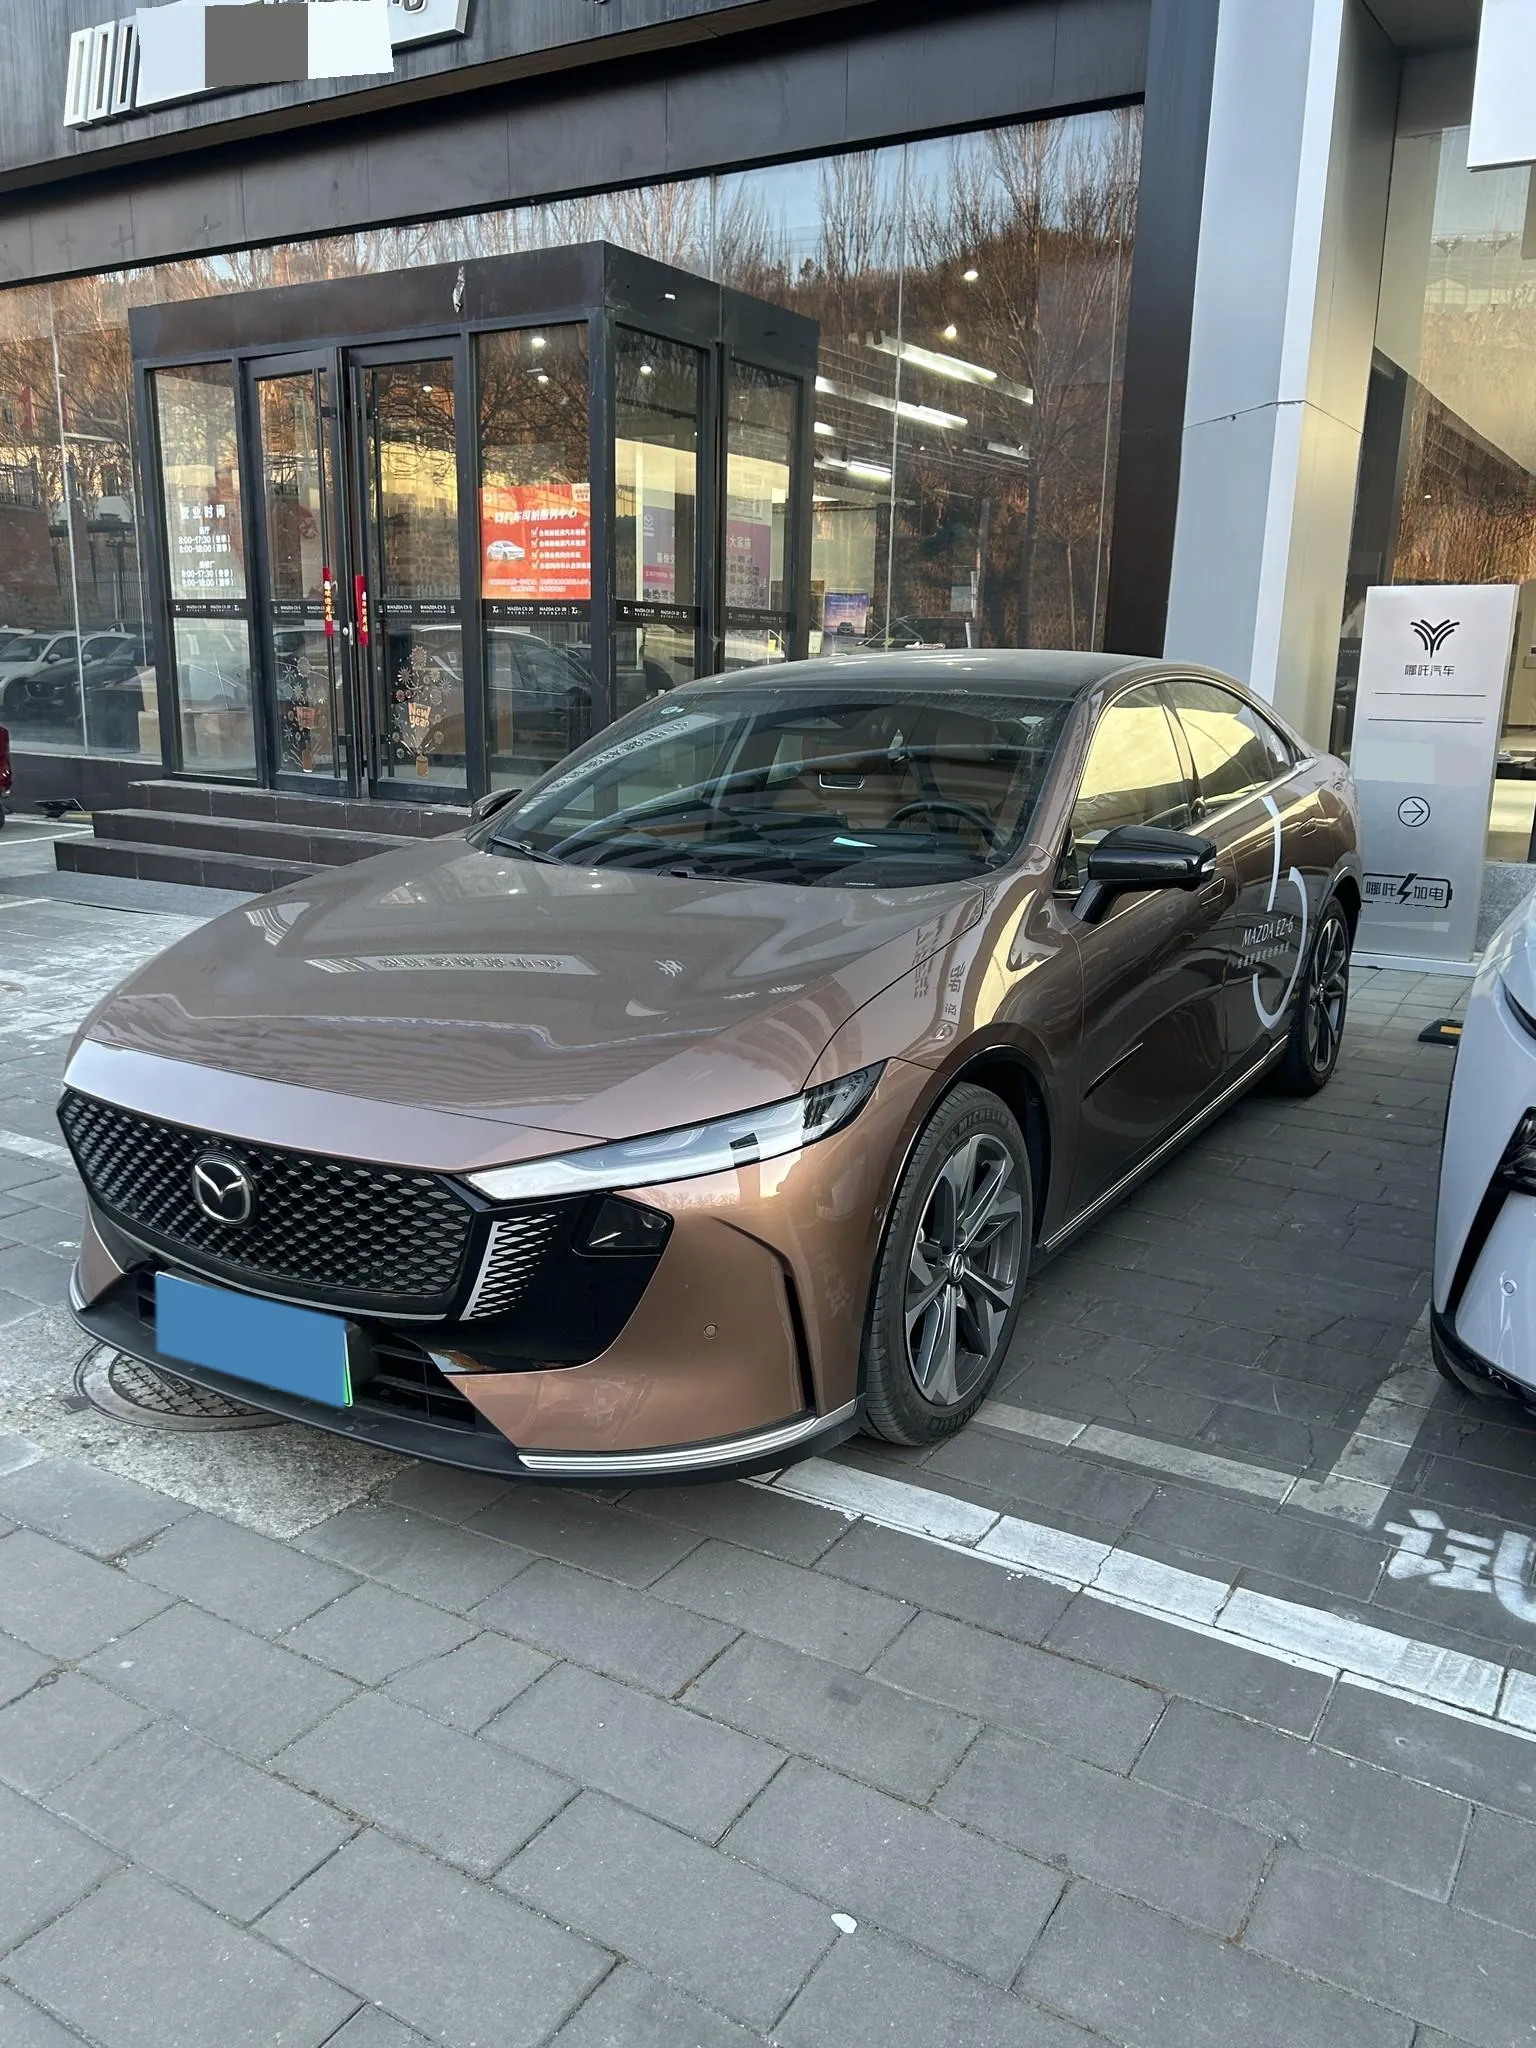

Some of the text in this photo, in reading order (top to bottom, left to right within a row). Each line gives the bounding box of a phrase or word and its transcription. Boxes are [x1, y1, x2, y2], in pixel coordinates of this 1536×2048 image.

[1404, 664, 1455, 677] 哪吒汽车
[408, 702, 431, 720] New
[1365, 881, 1444, 901] 哪吒 加电
[1241, 915, 1294, 948] MAZDA EZ-6
[958, 1108, 1009, 1135] MICHELIN
